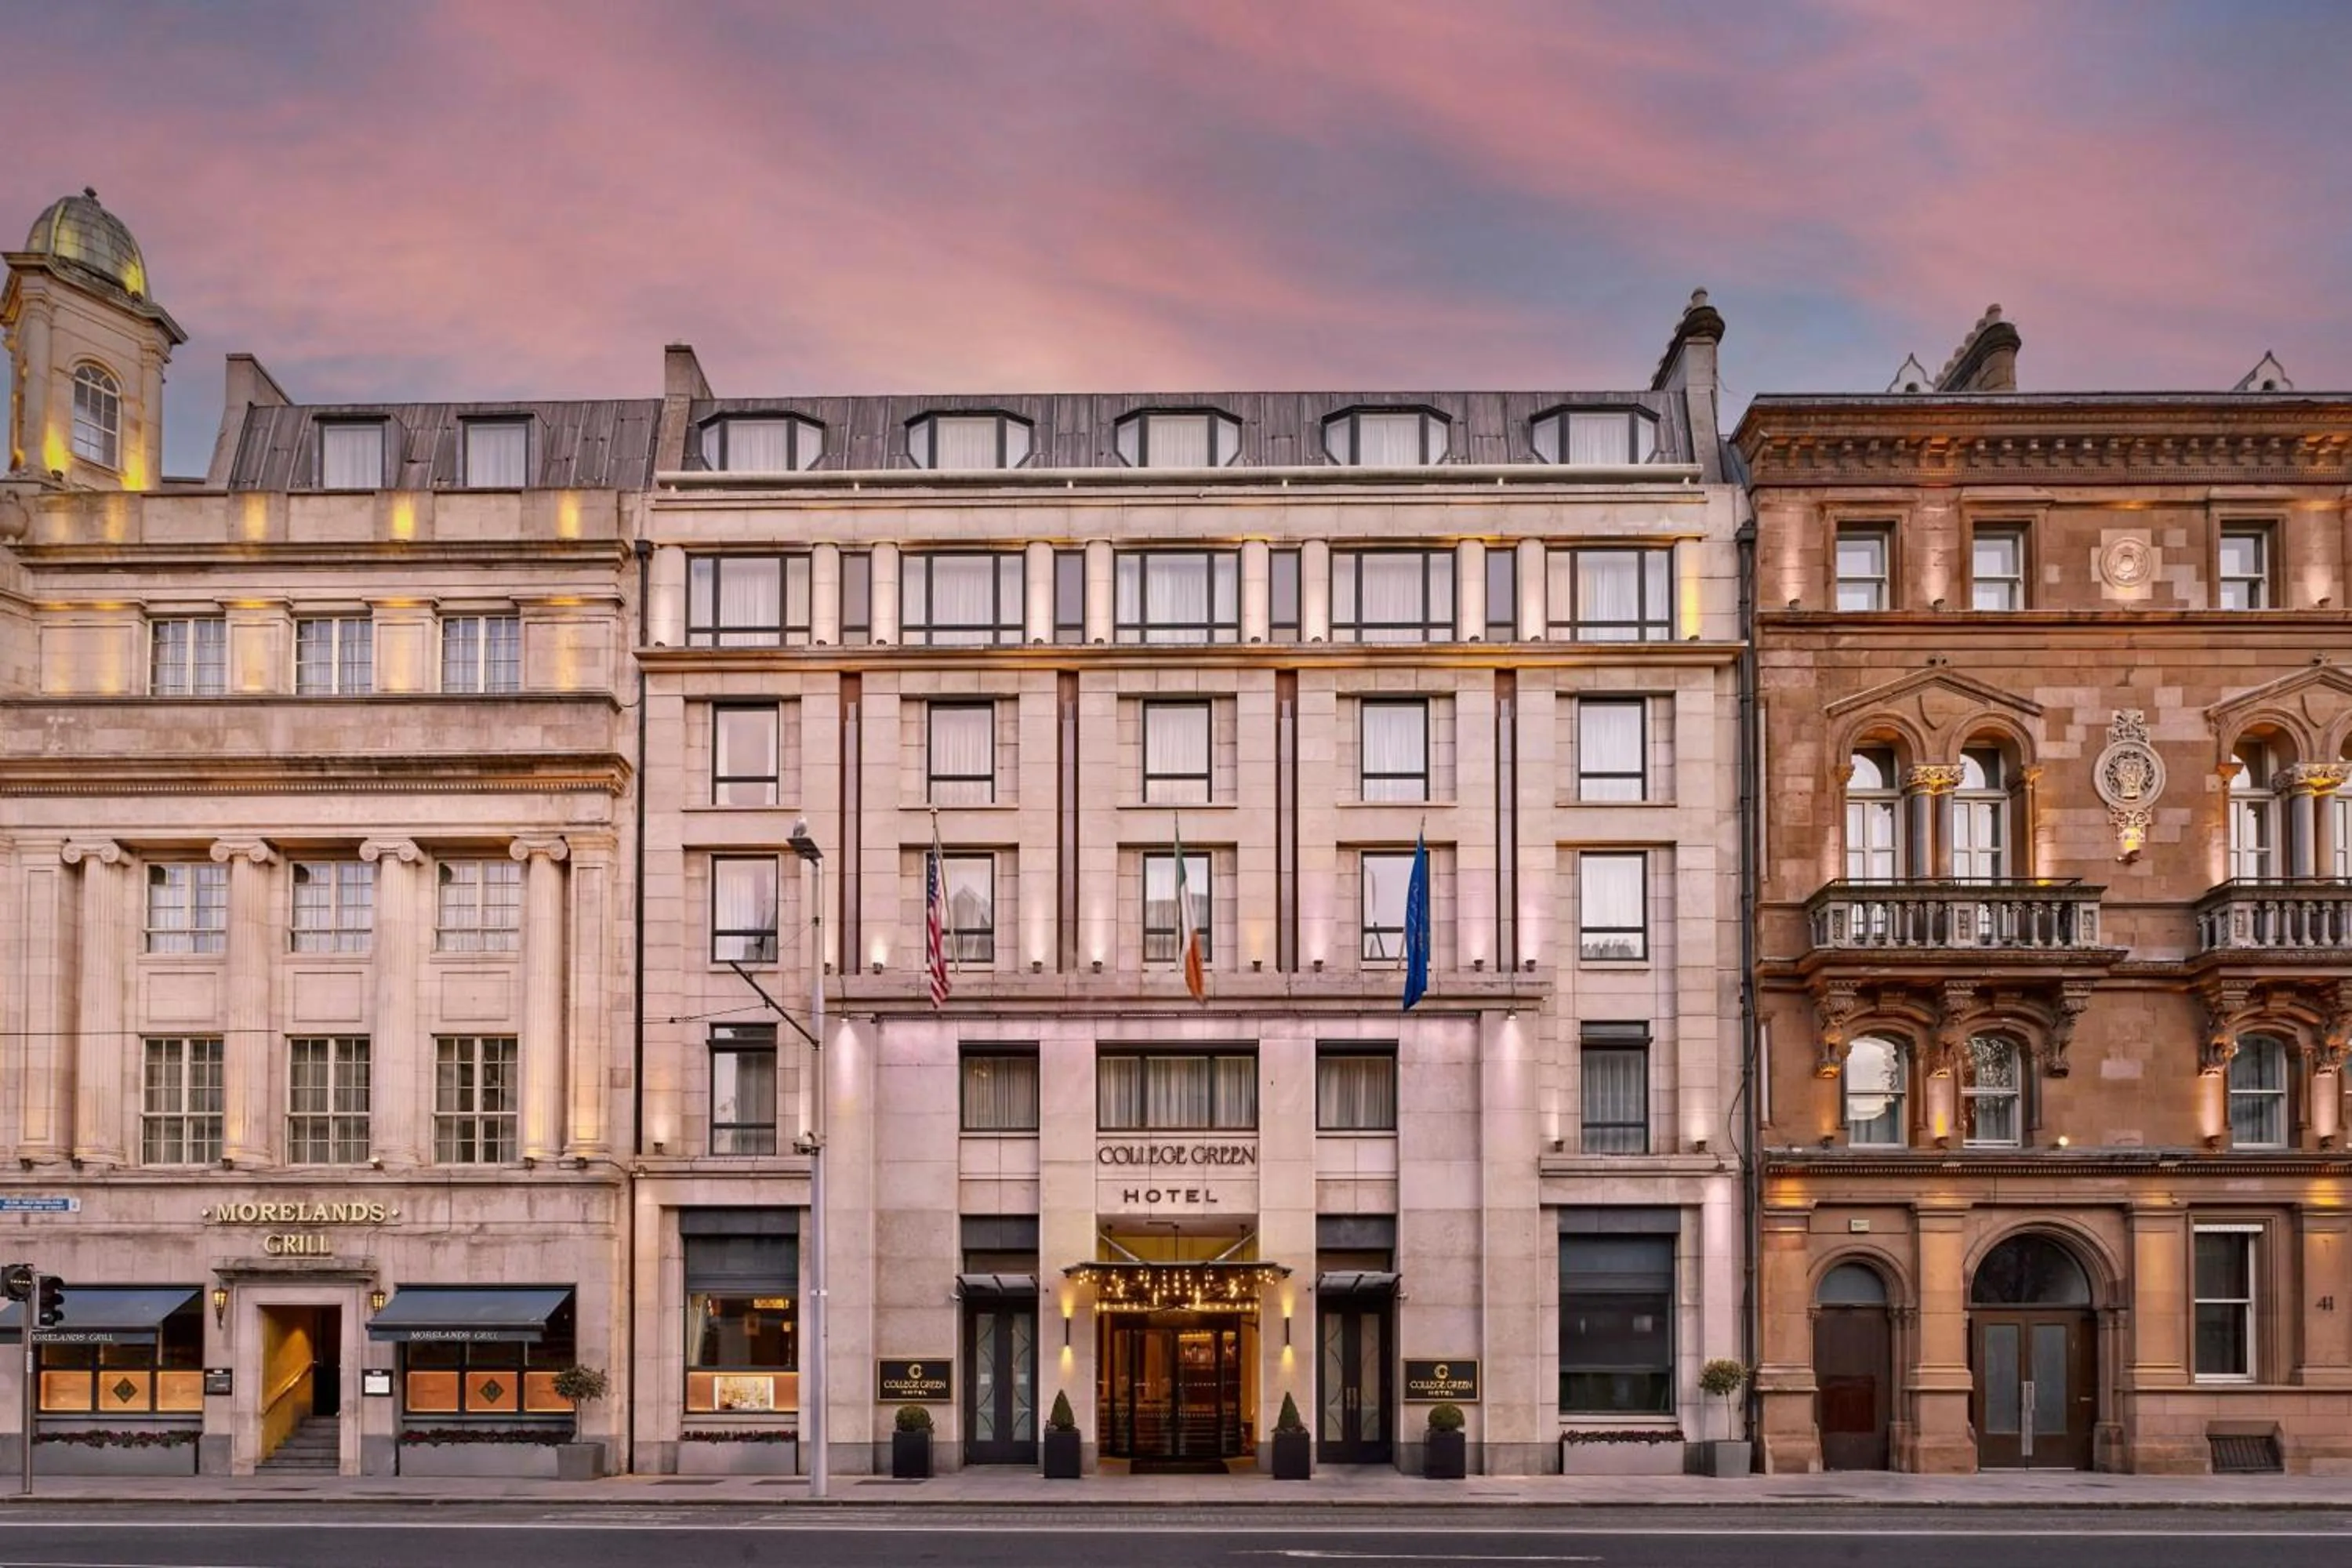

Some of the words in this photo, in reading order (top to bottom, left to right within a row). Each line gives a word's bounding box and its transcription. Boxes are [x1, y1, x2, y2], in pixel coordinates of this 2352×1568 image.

[1098, 1145, 1189, 1165] COLLEGE
[1191, 1145, 1256, 1165] GREEN
[1123, 1189, 1218, 1203] HOTEL
[215, 1203, 385, 1222] MORELANDS
[264, 1234, 332, 1254] GRILL
[31, 1333, 86, 1342] ORELANDS
